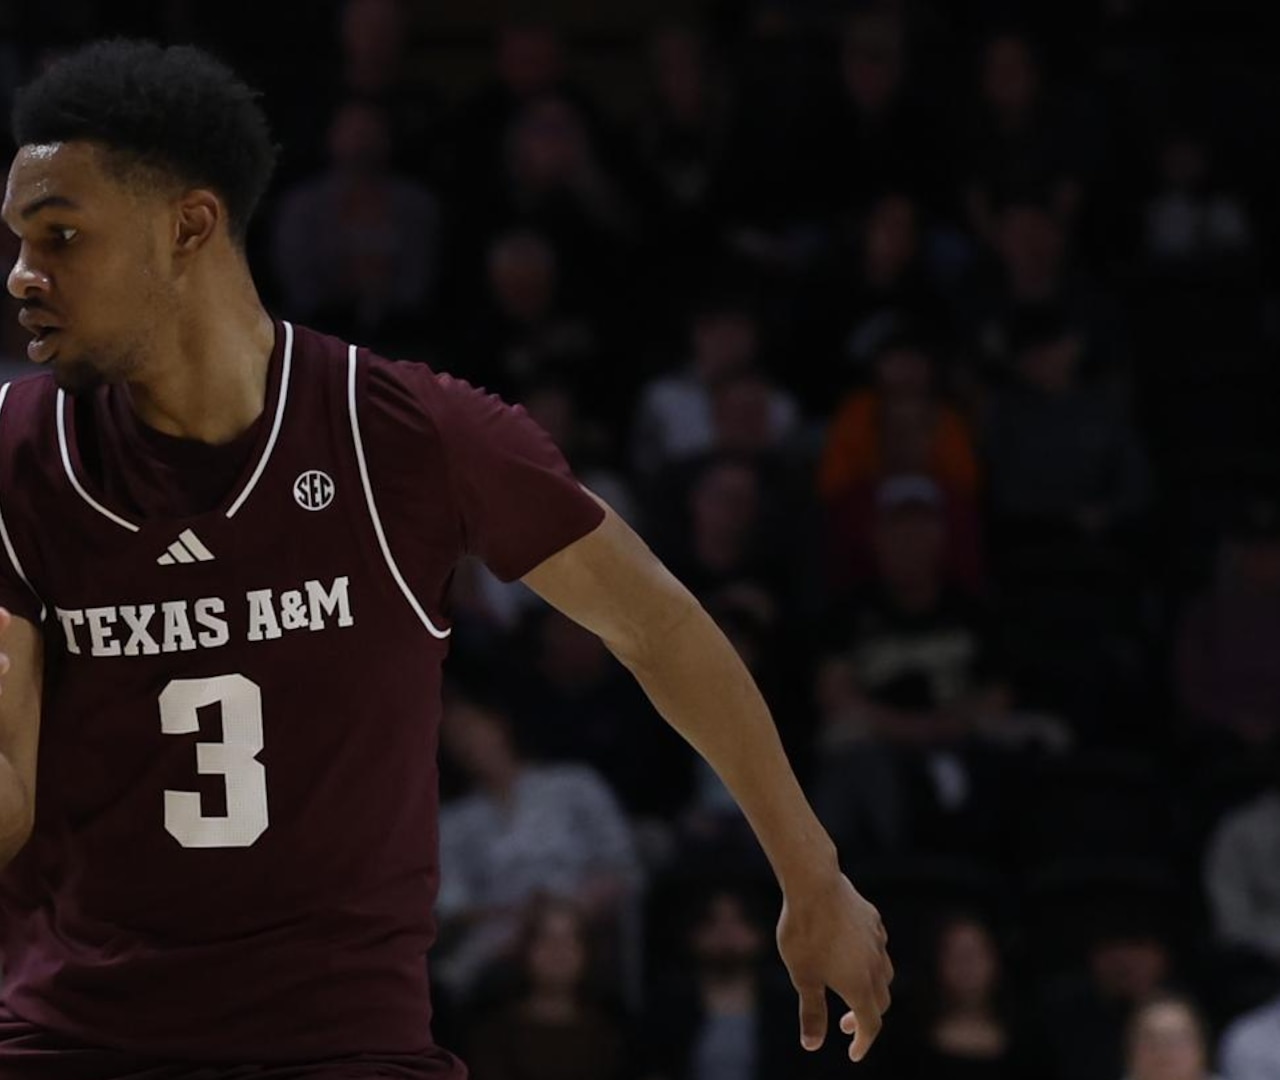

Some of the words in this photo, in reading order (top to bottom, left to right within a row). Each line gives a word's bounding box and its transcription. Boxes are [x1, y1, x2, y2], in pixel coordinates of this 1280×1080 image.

[295, 471, 333, 509] SEC
[54, 597, 230, 657] TEXAS
[246, 576, 354, 642] A&M
[157, 672, 270, 849] 3
